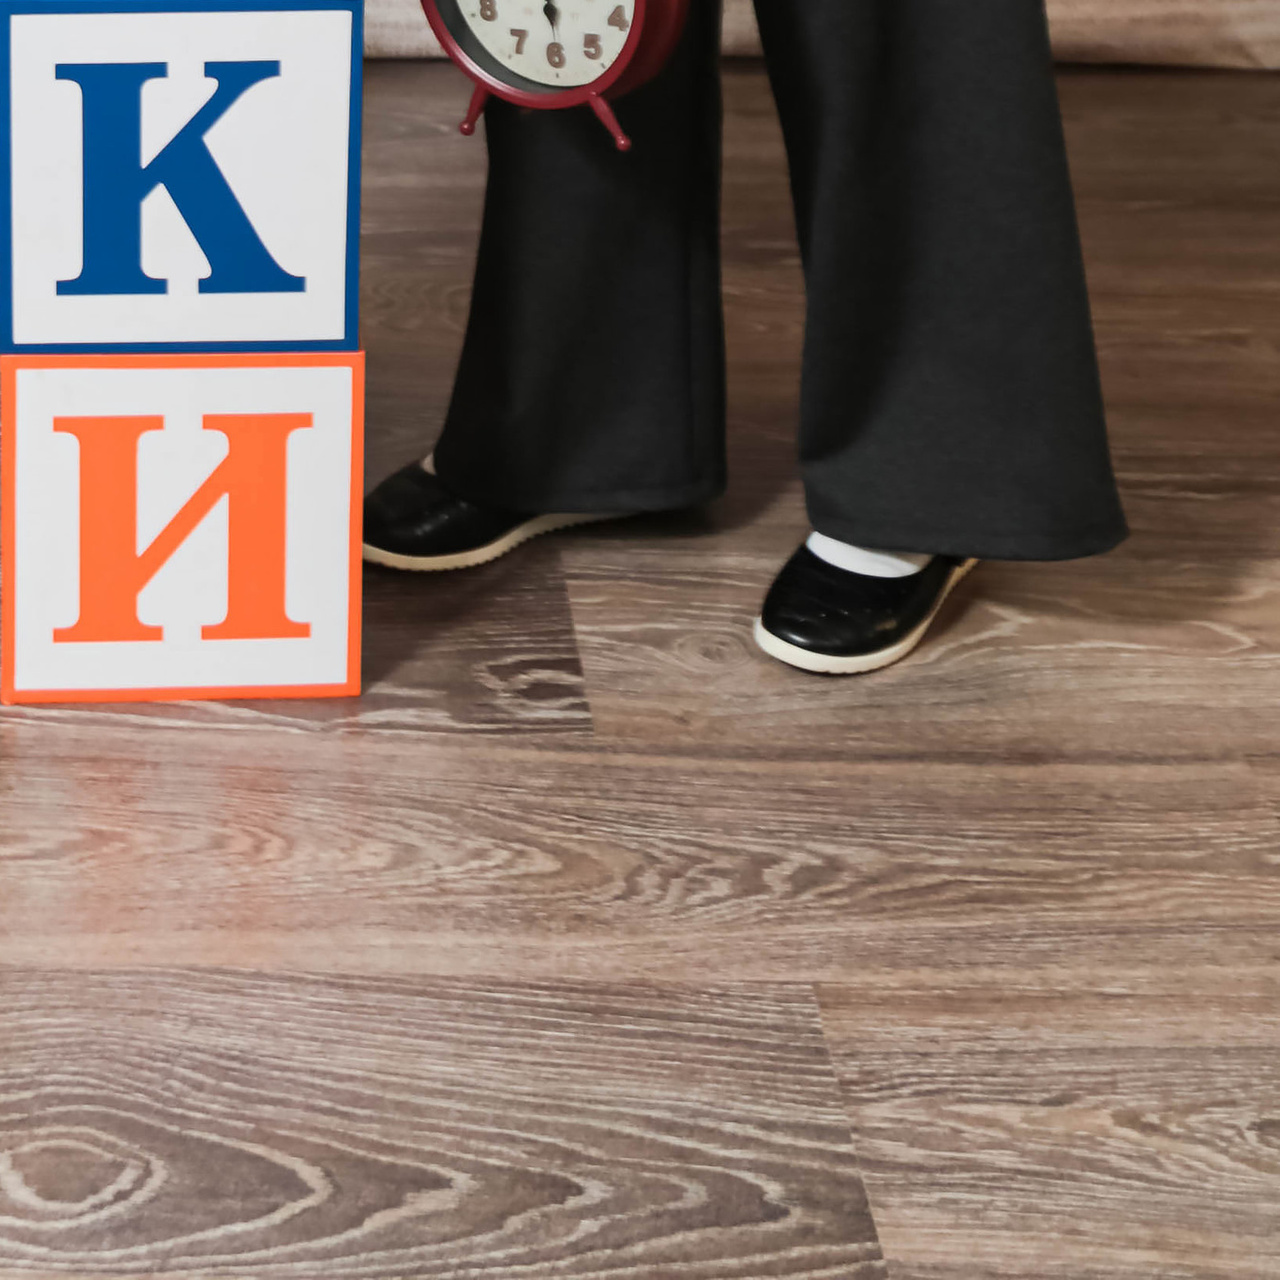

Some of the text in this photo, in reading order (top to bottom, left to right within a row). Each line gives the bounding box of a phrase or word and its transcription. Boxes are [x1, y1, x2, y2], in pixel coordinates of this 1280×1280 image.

[607, 5, 629, 32] 4
[510, 28, 528, 55] 7
[583, 33, 602, 60] 5
[546, 42, 566, 69] 6
